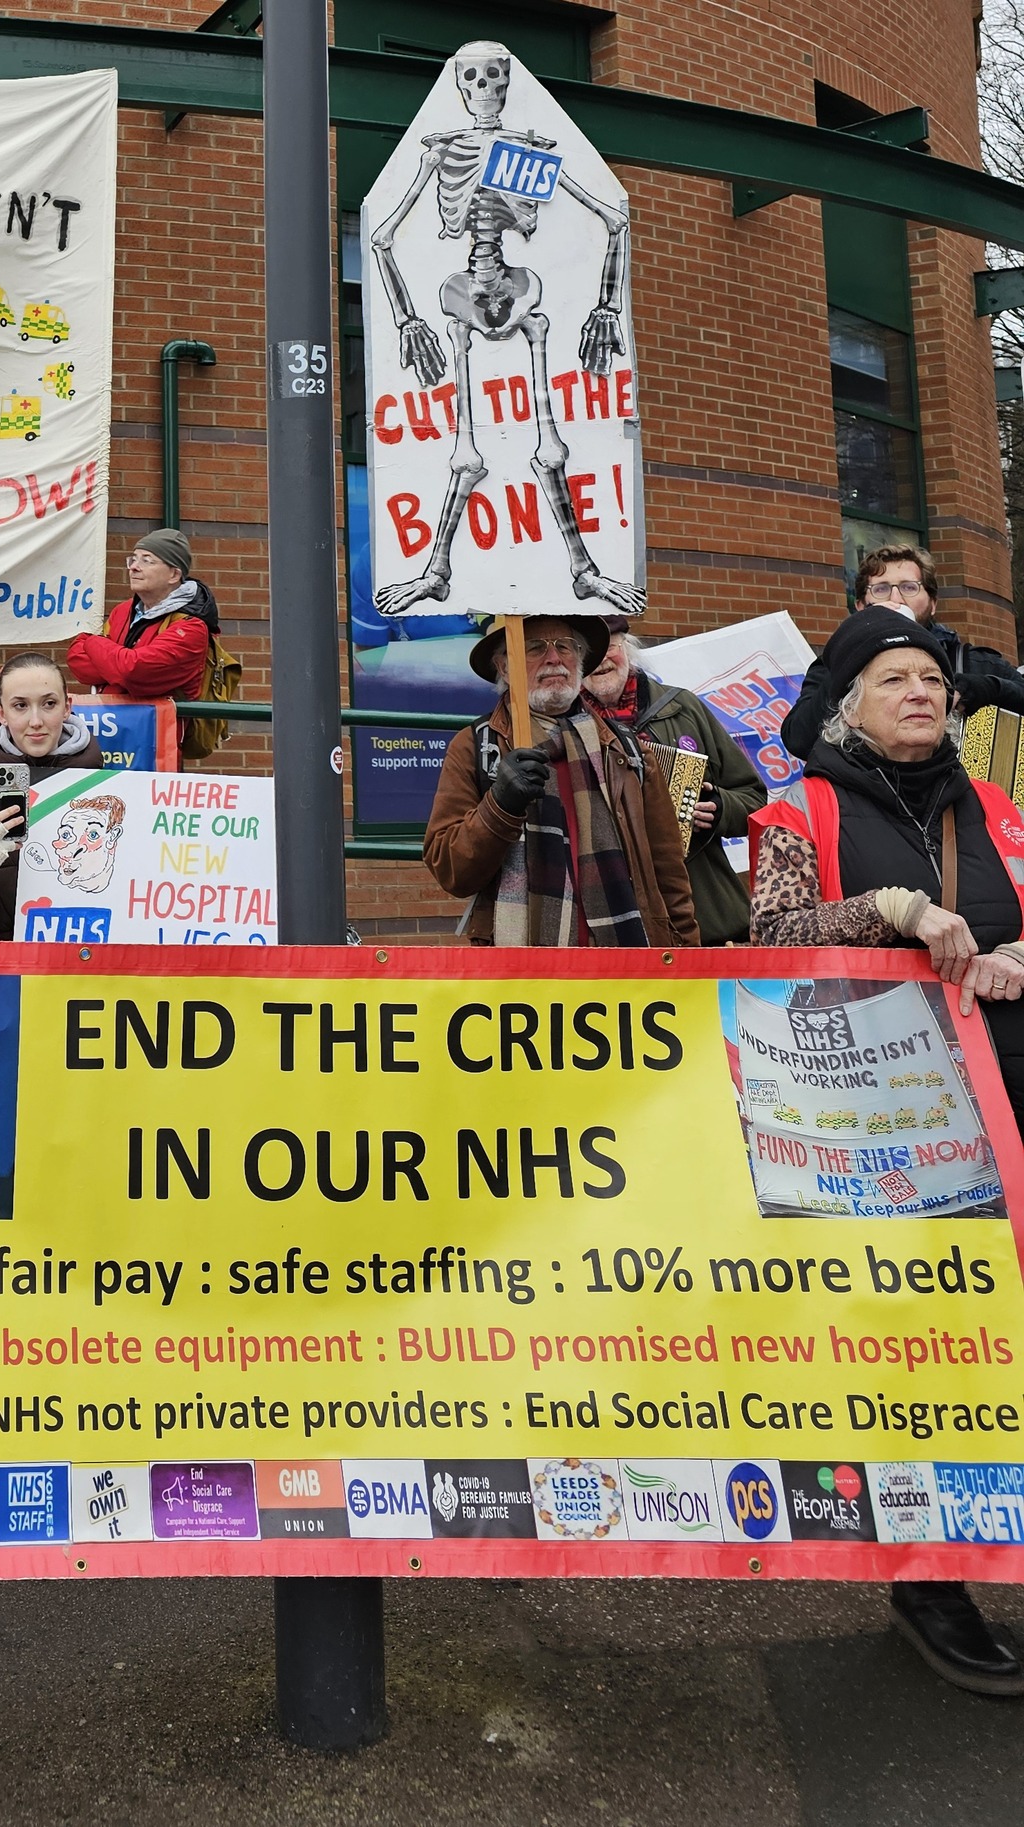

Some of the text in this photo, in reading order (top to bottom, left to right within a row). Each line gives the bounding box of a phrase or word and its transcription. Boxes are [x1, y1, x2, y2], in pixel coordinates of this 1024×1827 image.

[490, 149, 559, 195] NHS
[287, 344, 327, 374] 35
[291, 377, 326, 395] C23
[374, 369, 634, 446] CUT TO THE
[706, 668, 778, 717] NOT
[370, 736, 447, 752] Together, we
[102, 750, 136, 769] pay
[370, 756, 418, 771] support
[150, 778, 240, 810] WHERE
[151, 811, 260, 841] ARE OUR
[159, 841, 231, 877] NEW
[127, 878, 277, 926] HOSPITAL
[65, 999, 685, 1075] END THE CRISIS
[737, 1018, 933, 1073] UNDERFUNDING ISN'T
[795, 1029, 849, 1050] NHS
[789, 1069, 878, 1089] WORKING
[127, 1125, 628, 1203] IN OUR NHS
[755, 1131, 913, 1174] FUND THE NHS
[817, 1173, 865, 1198] NHS
[882, 1172, 904, 1188] NOT
[797, 1182, 1002, 1219] Leeds Keep our NHS Public
[93, 1258, 185, 1306] pay
[228, 1246, 331, 1297] safe
[345, 1245, 533, 1306] staffing
[580, 1245, 695, 1296] 10%
[708, 1253, 853, 1296] more
[865, 1243, 997, 1297] beds
[153, 1325, 364, 1373] equipment
[397, 1326, 516, 1364] BUILD
[528, 1324, 720, 1373] promised
[729, 1334, 816, 1364] new
[827, 1324, 1015, 1373] hospitals
[77, 1396, 142, 1433] not
[153, 1391, 291, 1439] private
[302, 1390, 490, 1439] providers
[525, 1390, 600, 1430] End
[612, 1390, 731, 1432] Social
[739, 1391, 834, 1432] Care
[92, 1469, 114, 1493] we
[190, 1467, 204, 1481] End
[278, 1468, 321, 1498] GMB
[458, 1476, 490, 1490] COVID-19
[551, 1477, 600, 1490] LEEDS
[889, 1472, 914, 1486] national
[934, 1468, 987, 1495] HEALTH
[9, 1474, 45, 1505] NHS
[191, 1484, 233, 1497] Social Care
[371, 1482, 428, 1515] BMA
[460, 1491, 532, 1505] BEREAVED FAMILIES
[553, 1490, 601, 1500] TRADES
[791, 1489, 805, 1500] THE
[878, 1485, 931, 1508] education
[45, 1469, 55, 1539] VOICES
[89, 1487, 127, 1521] own
[192, 1500, 223, 1515] Disgrace
[462, 1507, 510, 1519] FOR JUSTICE
[555, 1501, 602, 1513] UNION
[632, 1491, 711, 1523] UNISON
[731, 1479, 774, 1533] pcs
[897, 1510, 916, 1522] union
[8, 1510, 46, 1533] STAFF
[108, 1516, 122, 1540] it
[228, 1517, 246, 1527] Support
[284, 1519, 325, 1532] UNION
[557, 1513, 603, 1522] COUNCIL
[224, 1528, 240, 1536] Service
